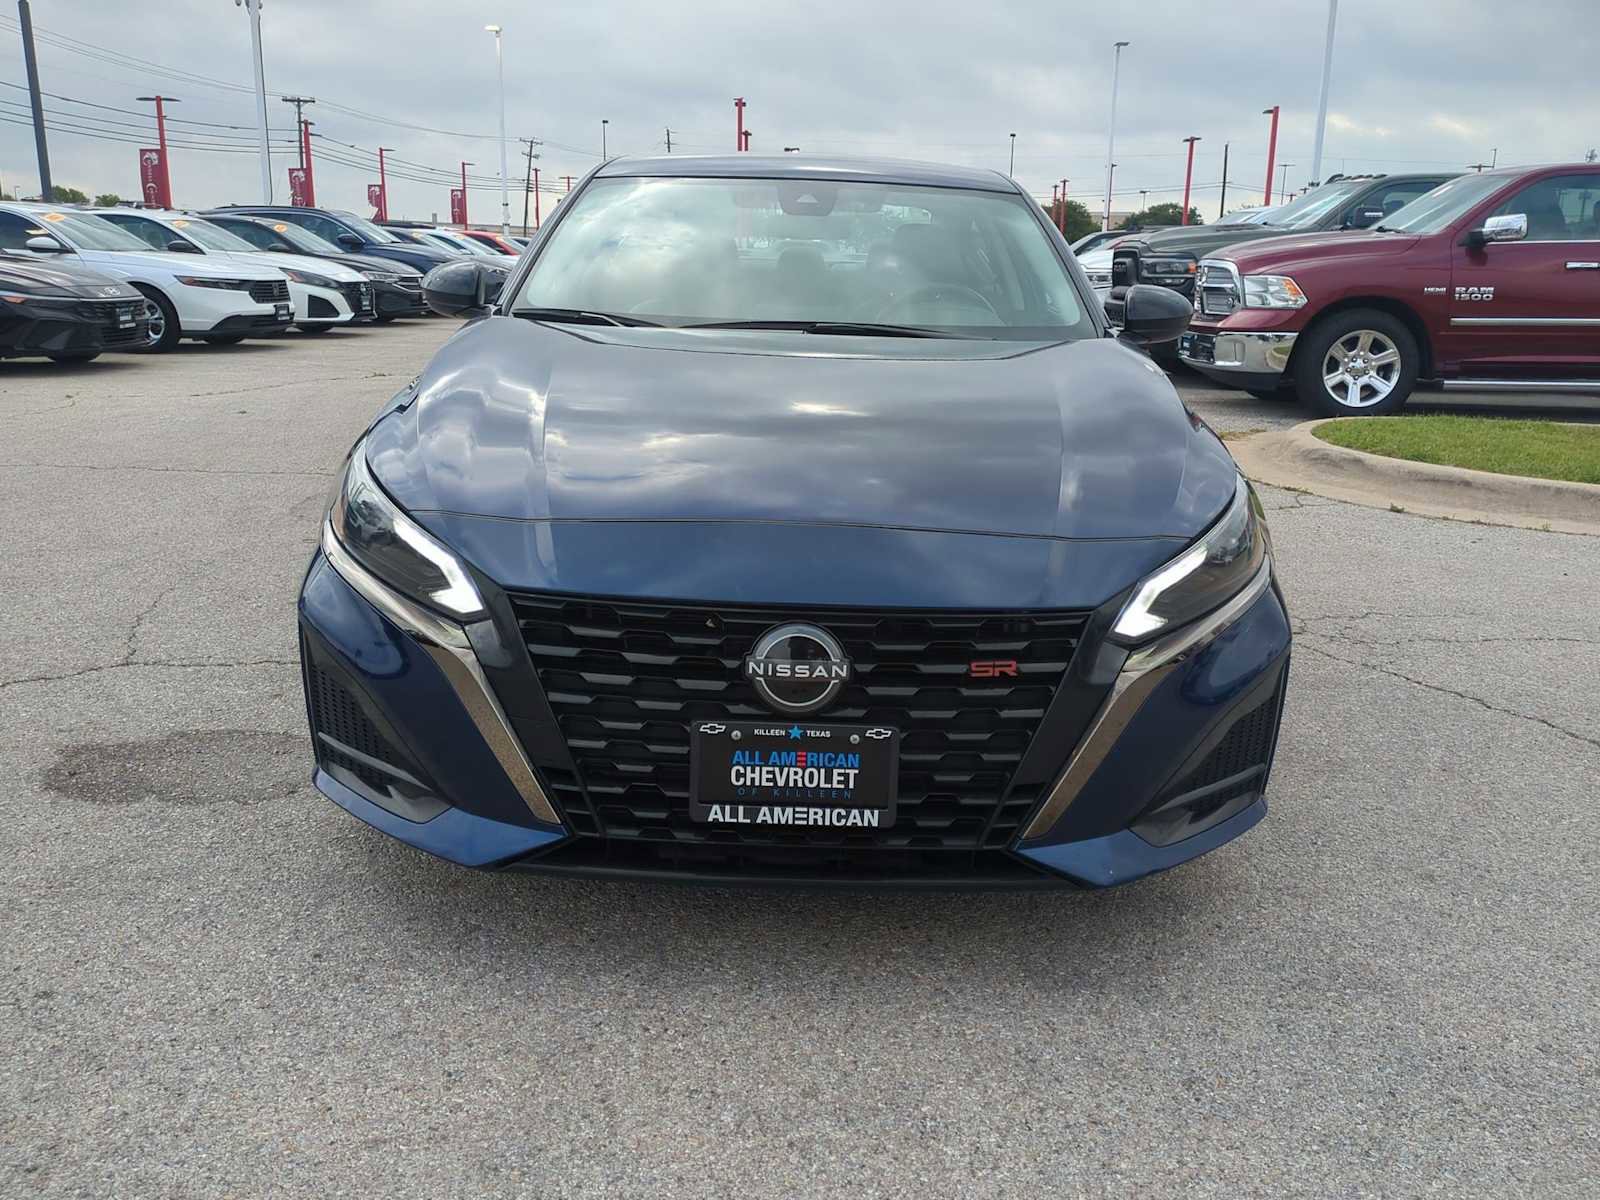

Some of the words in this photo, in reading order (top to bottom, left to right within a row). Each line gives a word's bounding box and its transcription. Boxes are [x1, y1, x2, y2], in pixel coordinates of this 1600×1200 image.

[1455, 293, 1493, 301] 1500
[747, 661, 847, 678] NISSAN
[969, 660, 1018, 677] SR
[806, 730, 831, 738] TEXAS
[732, 751, 764, 765] ALL
[768, 751, 859, 768] AMERICAN
[731, 766, 859, 789] CHEVROLET
[737, 788, 757, 796] OF
[773, 789, 851, 798] KILLEEN
[707, 804, 751, 823] ALL
[756, 806, 879, 827] AMERICAN
